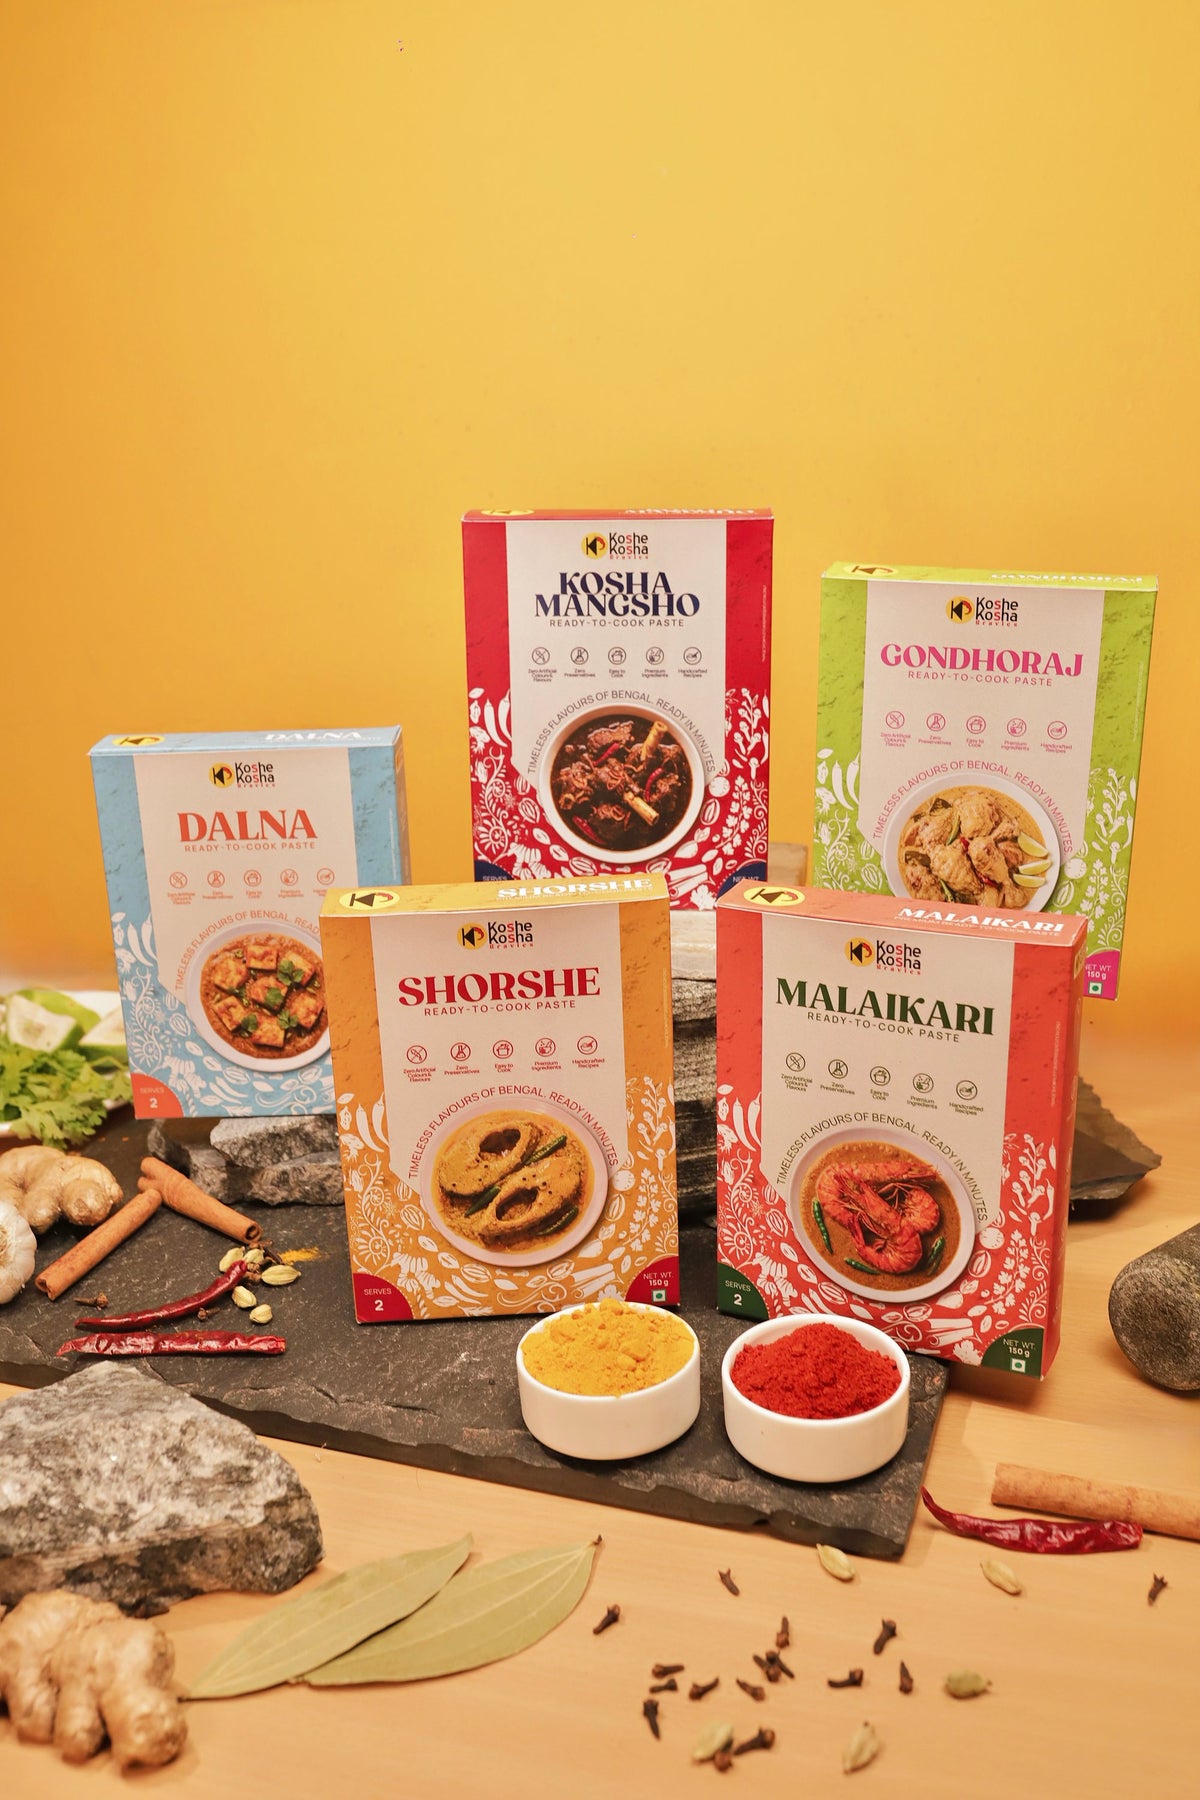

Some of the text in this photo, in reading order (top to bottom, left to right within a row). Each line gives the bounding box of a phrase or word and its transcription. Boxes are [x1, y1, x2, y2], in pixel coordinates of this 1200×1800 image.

[609, 532, 648, 544] Koshe
[609, 545, 648, 555] Kosha
[559, 572, 672, 594] KOSHA
[535, 593, 700, 617] MANGSHO
[976, 597, 1018, 610] Koshe
[976, 611, 1018, 621] Kosha
[550, 619, 684, 628] READY-TO-COOK PASTE
[880, 643, 1084, 677] GONDHORAJ
[908, 671, 1052, 687] READY-TO-COOK PASTE
[265, 732, 362, 741] DALNA
[528, 728, 551, 774] TIMELESS
[549, 696, 594, 730] FLAVOURS
[595, 691, 608, 702] OF
[656, 698, 687, 721] READY
[685, 719, 695, 731] IN
[235, 762, 273, 772] Koshe
[236, 774, 274, 783] Kosha
[873, 792, 900, 840] TIMELESS
[898, 761, 948, 796] FLAVOURS
[950, 760, 964, 769] OF
[1014, 772, 1047, 795] READY
[1045, 795, 1054, 807] IN
[177, 809, 317, 842] DALNA
[184, 842, 276, 852] READY-TO-COOK
[498, 879, 652, 898] SHORSHE
[488, 920, 532, 933] Koshe
[898, 908, 1064, 932] MALAIKARI
[489, 933, 533, 944] Kosha
[175, 944, 195, 990] TIMELESS
[193, 915, 234, 949] FLAVOURS
[235, 912, 248, 921] OF
[877, 940, 921, 957] Koshe
[877, 956, 920, 969] Kosha
[398, 967, 600, 1007] SHORSHE
[424, 1000, 575, 1016] READY-TO-COOK PASTE
[776, 977, 995, 1036] MALAIKARI
[808, 1011, 960, 1043] READY-TO-COOK PASTE
[149, 1098, 158, 1108] 2
[408, 1129, 433, 1178] TIMELESS
[430, 1092, 479, 1131] FLAVOURS
[481, 1087, 496, 1098] OF
[549, 1091, 584, 1115] READY
[582, 1111, 594, 1124] IN
[776, 1142, 804, 1185] TIMELESS
[800, 1113, 852, 1145] FLAVOURS
[854, 1112, 869, 1122] OF
[922, 1131, 956, 1160] READY
[954, 1159, 967, 1172] IN
[643, 1272, 657, 1280] NET
[364, 1288, 392, 1296] SERVES
[725, 1280, 751, 1292] SERVES
[374, 1300, 384, 1311] 2
[734, 1294, 742, 1306] 2
[1003, 1339, 1019, 1347] NET
[1009, 1347, 1030, 1358] 150 g
